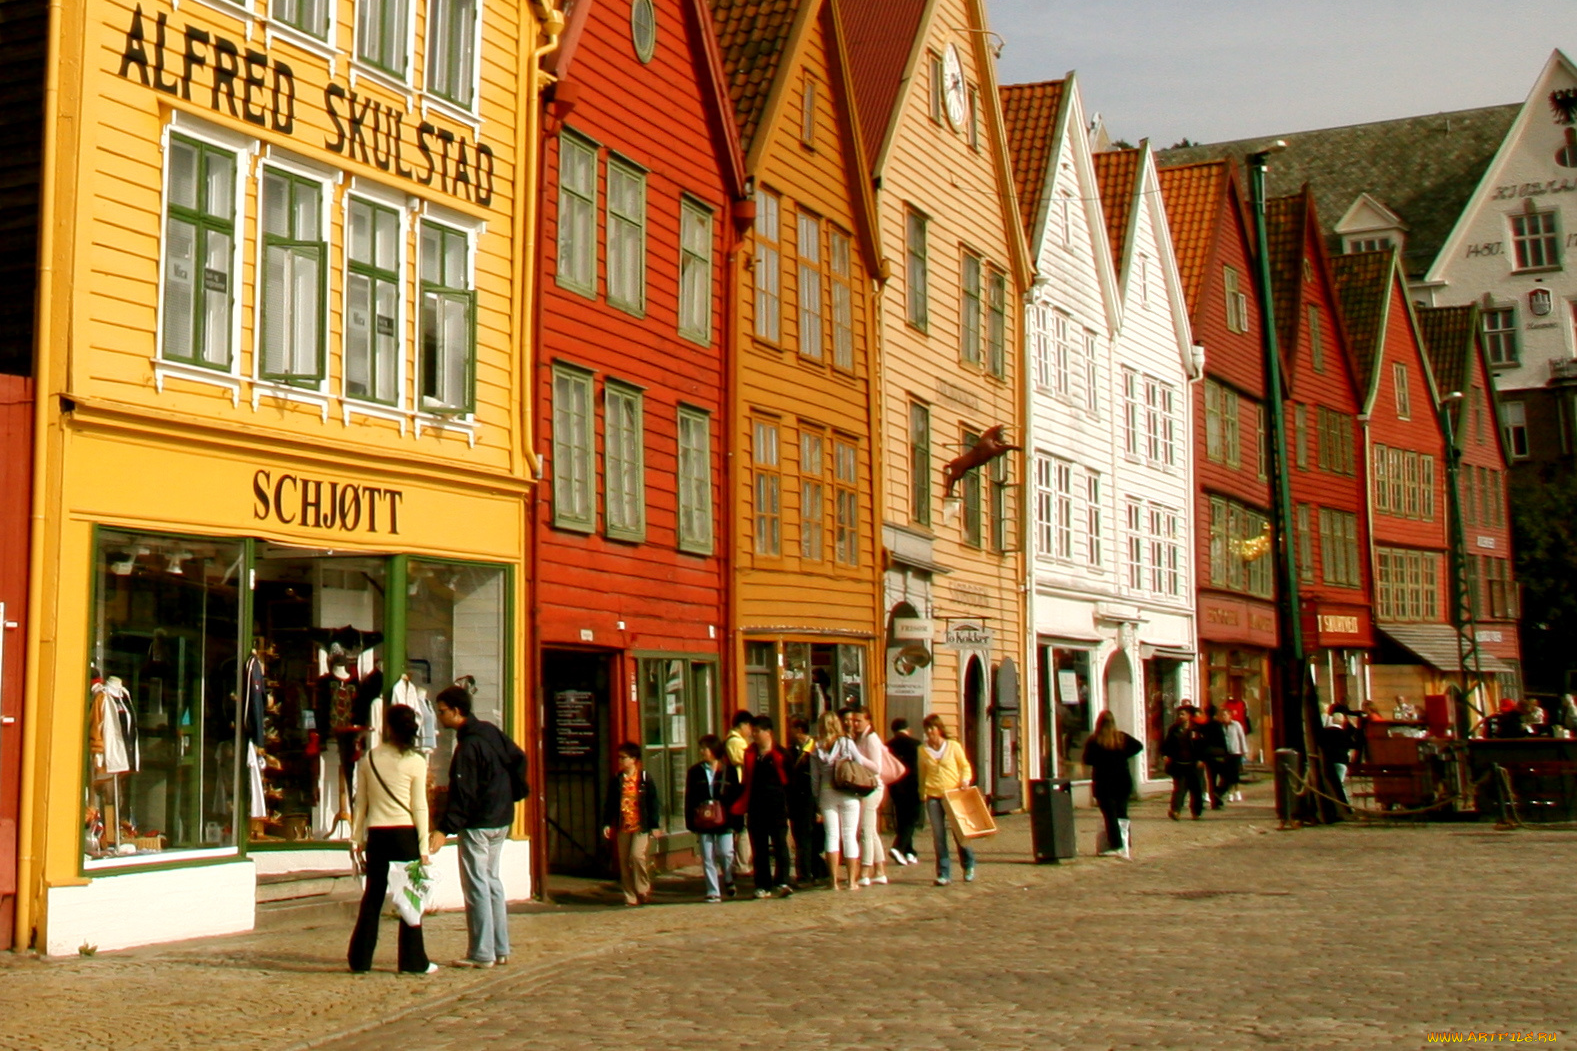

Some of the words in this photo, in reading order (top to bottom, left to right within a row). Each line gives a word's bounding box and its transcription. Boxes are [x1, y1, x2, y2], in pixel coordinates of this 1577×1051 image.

[118, 2, 297, 136] ALFRED
[323, 81, 496, 209] SKULSTAD
[252, 469, 403, 535] SCHJØTT
